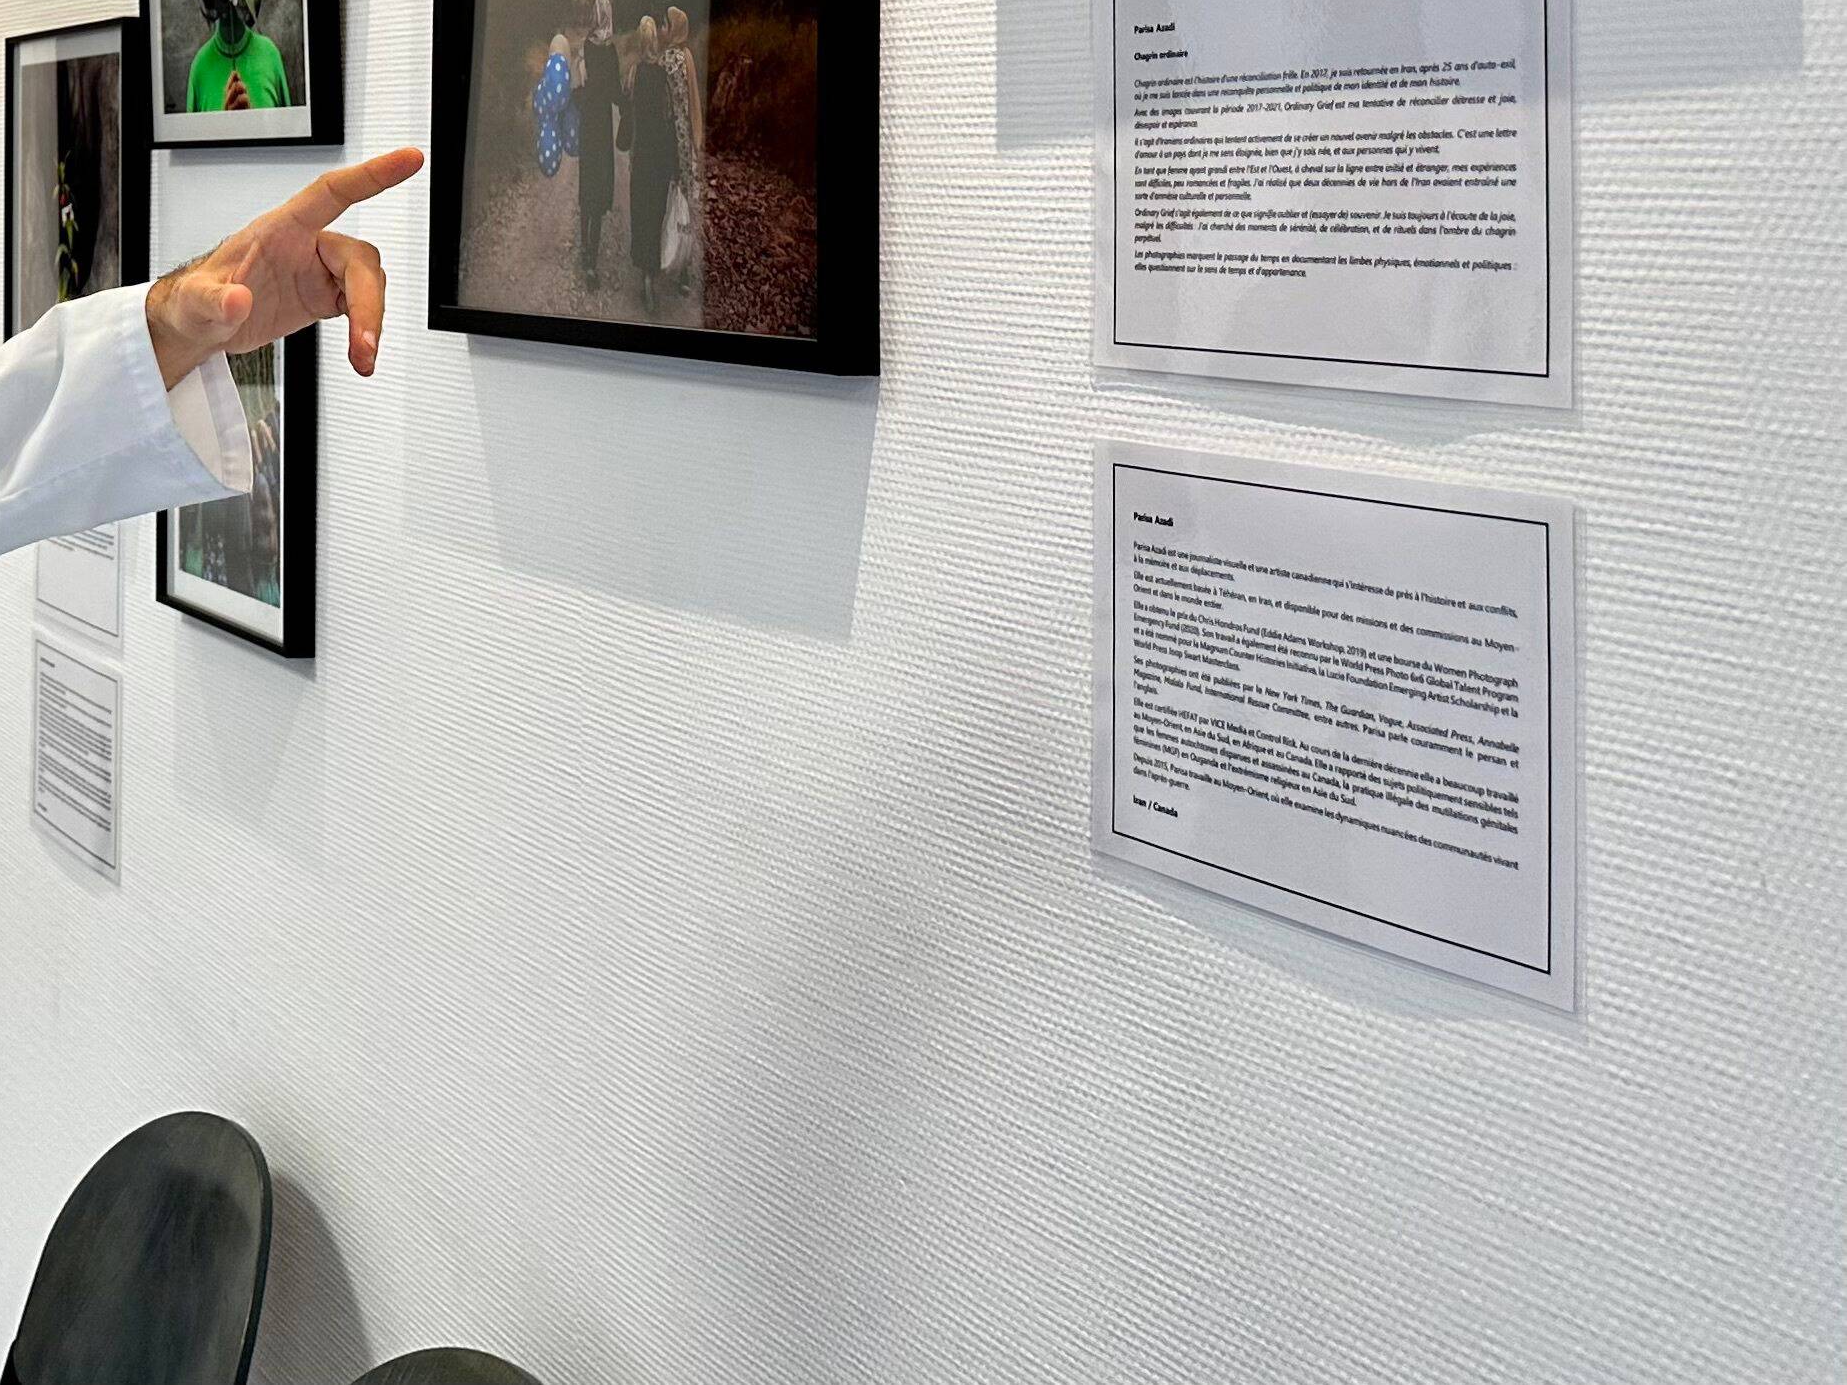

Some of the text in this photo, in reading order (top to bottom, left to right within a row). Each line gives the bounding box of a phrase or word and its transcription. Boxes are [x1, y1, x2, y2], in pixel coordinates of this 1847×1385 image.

[1419, 63, 1440, 75] après
[1442, 62, 1452, 71] 25
[1454, 63, 1469, 71] ans
[1390, 79, 1398, 88] et
[1399, 78, 1408, 88] de
[1397, 97, 1406, 106] de
[1488, 93, 1497, 103] et
[1406, 130, 1416, 139] les
[1457, 128, 1477, 138] C'est
[1395, 145, 1408, 156] qui
[1409, 147, 1414, 156] y
[1345, 164, 1364, 174] ligne
[1365, 163, 1384, 172] entre
[1406, 163, 1414, 172] et
[1452, 164, 1469, 172] mes
[1357, 178, 1367, 186] de
[1369, 178, 1380, 186] vie
[1381, 177, 1398, 186] hors
[1400, 177, 1409, 186] de
[1383, 210, 1391, 219] Je
[1392, 210, 1407, 220] suis
[1479, 211, 1488, 220] de
[1490, 211, 1498, 221] la
[1373, 224, 1380, 233] et
[1382, 224, 1392, 233] de
[1418, 225, 1437, 234] dans
[1471, 225, 1482, 235] du
[1462, 259, 1470, 268] et
[1384, 586, 1394, 597] de
[1396, 588, 1413, 602] près
[1457, 599, 1466, 609] et
[1469, 603, 1484, 613] aux
[1390, 620, 1398, 631] et
[1400, 622, 1414, 634] des
[1471, 638, 1482, 647] au
[1368, 649, 1376, 659] et
[1377, 653, 1392, 663] une
[1422, 660, 1433, 671] du
[1434, 662, 1467, 678] Women
[1364, 662, 1384, 675] Press
[1386, 666, 1409, 680] Photo
[1410, 671, 1424, 683] 6x6
[1501, 705, 1509, 717] et
[1511, 708, 1518, 719] la
[1388, 729, 1409, 745] parle
[1465, 747, 1474, 759] le
[1510, 758, 1519, 770] et
[1420, 770, 1435, 783] elle
[1435, 777, 1441, 785] a
[1368, 771, 1381, 784] des
[1503, 807, 1518, 820] tels
[1415, 799, 1429, 811] des
[1418, 833, 1432, 847] des
